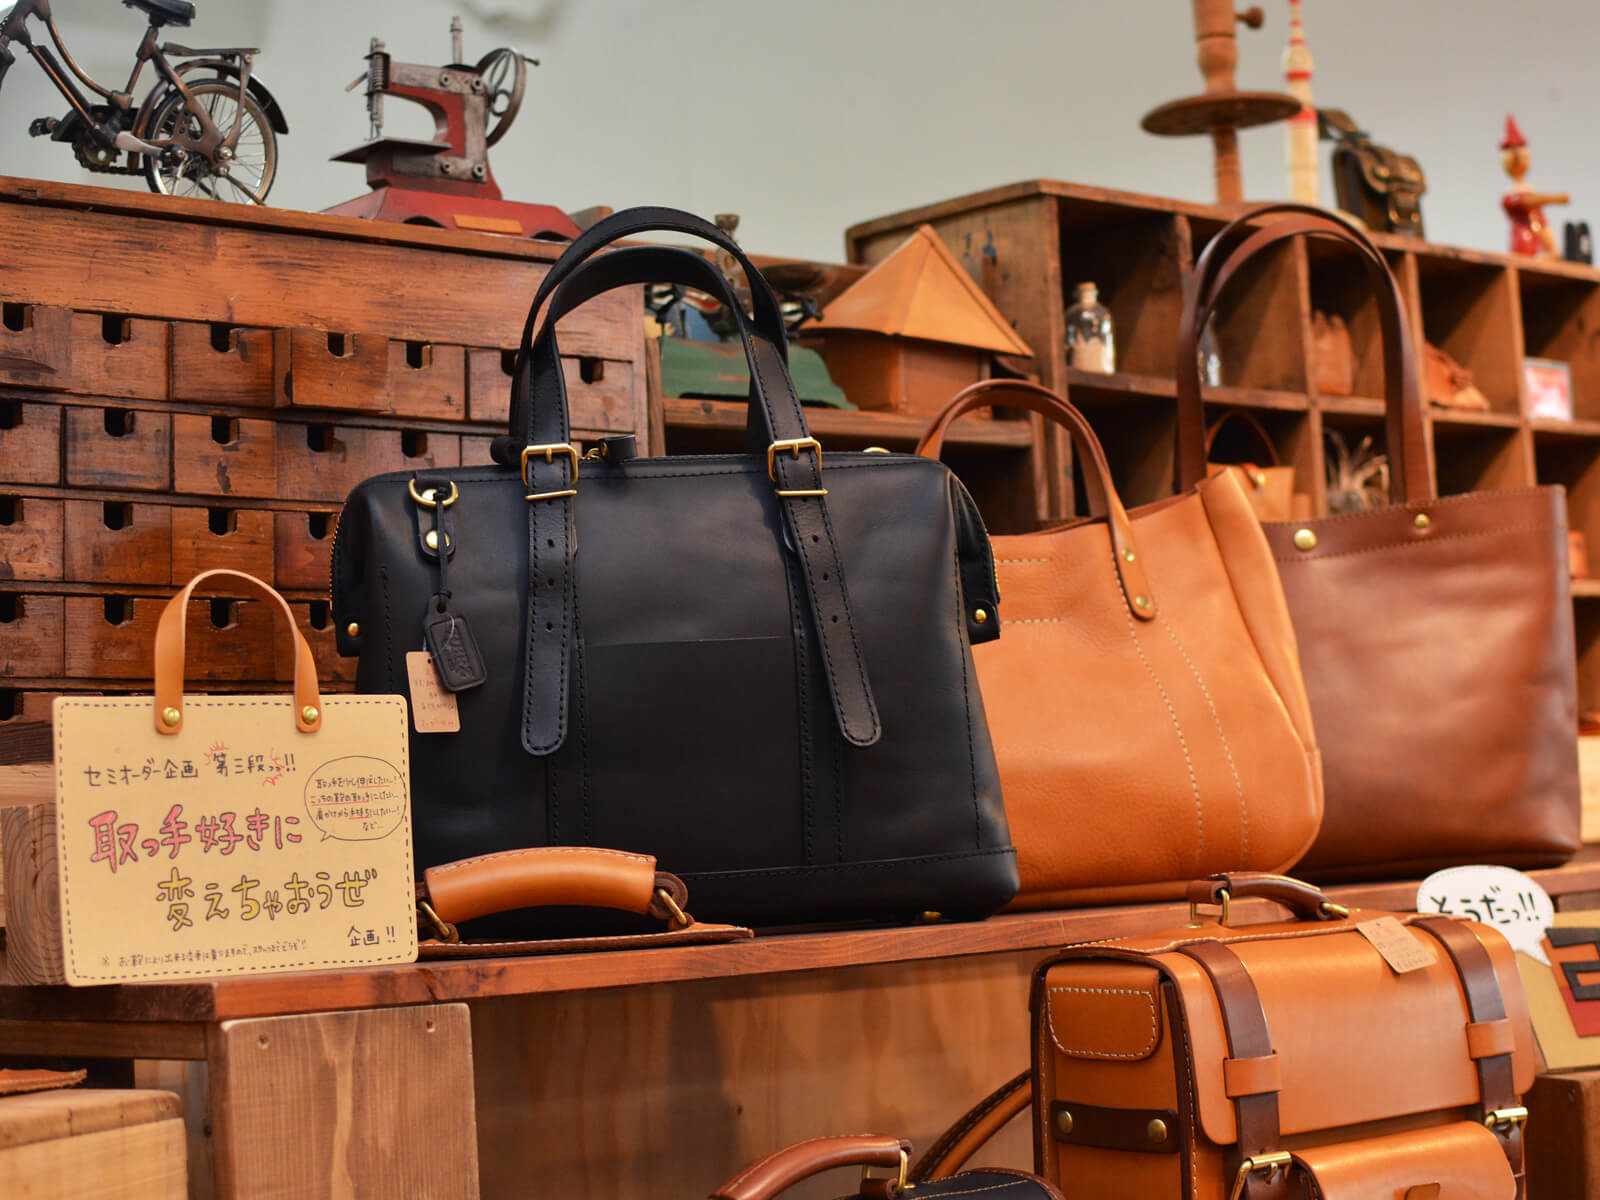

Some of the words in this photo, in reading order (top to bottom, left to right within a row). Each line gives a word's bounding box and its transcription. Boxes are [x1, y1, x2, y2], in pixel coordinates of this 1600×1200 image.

[84, 757, 199, 787] セミオーダー企画
[87, 803, 303, 875] 取っ手好きに
[156, 866, 378, 932] 変えちゃおうぜ
